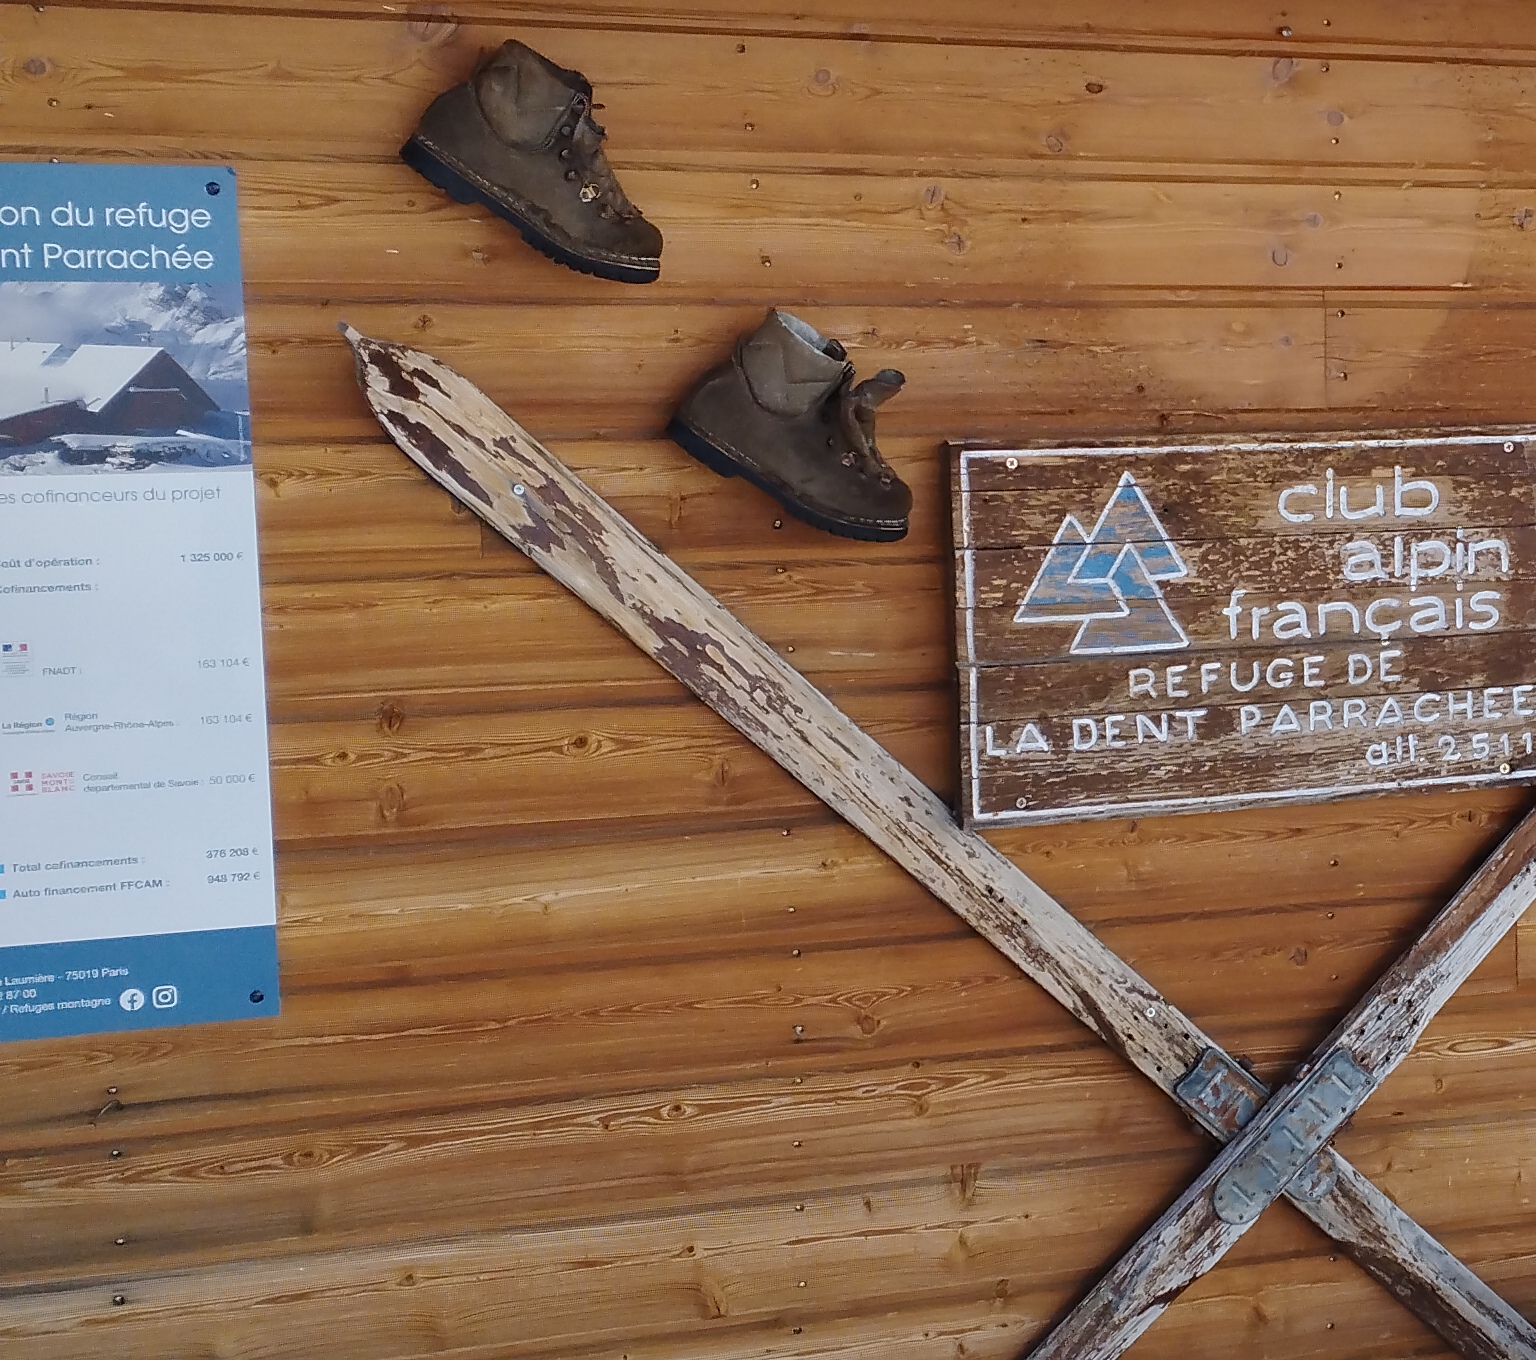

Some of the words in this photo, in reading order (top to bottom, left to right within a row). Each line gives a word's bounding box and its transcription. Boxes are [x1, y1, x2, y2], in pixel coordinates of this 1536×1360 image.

[51, 201, 94, 227] du
[105, 202, 212, 234] refuge
[43, 243, 214, 270] Parrachée
[21, 489, 138, 505] cofinanceurs
[142, 488, 166, 502] du
[171, 486, 221, 504] projet
[1277, 466, 1440, 523] club
[0, 558, 21, 569] oût
[24, 556, 93, 569] d'opération
[189, 552, 211, 562] 325
[213, 551, 234, 562] 000
[1342, 526, 1510, 592] alpin
[0, 582, 92, 594] ofinancements
[1221, 580, 1501, 645] français
[198, 658, 216, 669] 163
[220, 658, 240, 668] 104
[1129, 654, 1326, 700] REFUGE
[1348, 649, 1402, 686] DE
[985, 722, 1051, 757] LA
[1073, 707, 1208, 753] DENT
[1240, 683, 1536, 737] PARRACHEE
[1365, 733, 1427, 767] alt.
[1438, 731, 1534, 762] 2511
[153, 779, 165, 789] de
[209, 775, 223, 785] 50
[13, 862, 41, 873] Total
[13, 889, 40, 898] Auto
[44, 882, 117, 896] financement
[120, 879, 163, 891] FFCAM
[65, 968, 99, 981] 75019
[101, 967, 129, 978] Paris
[57, 996, 112, 1010] montagne
